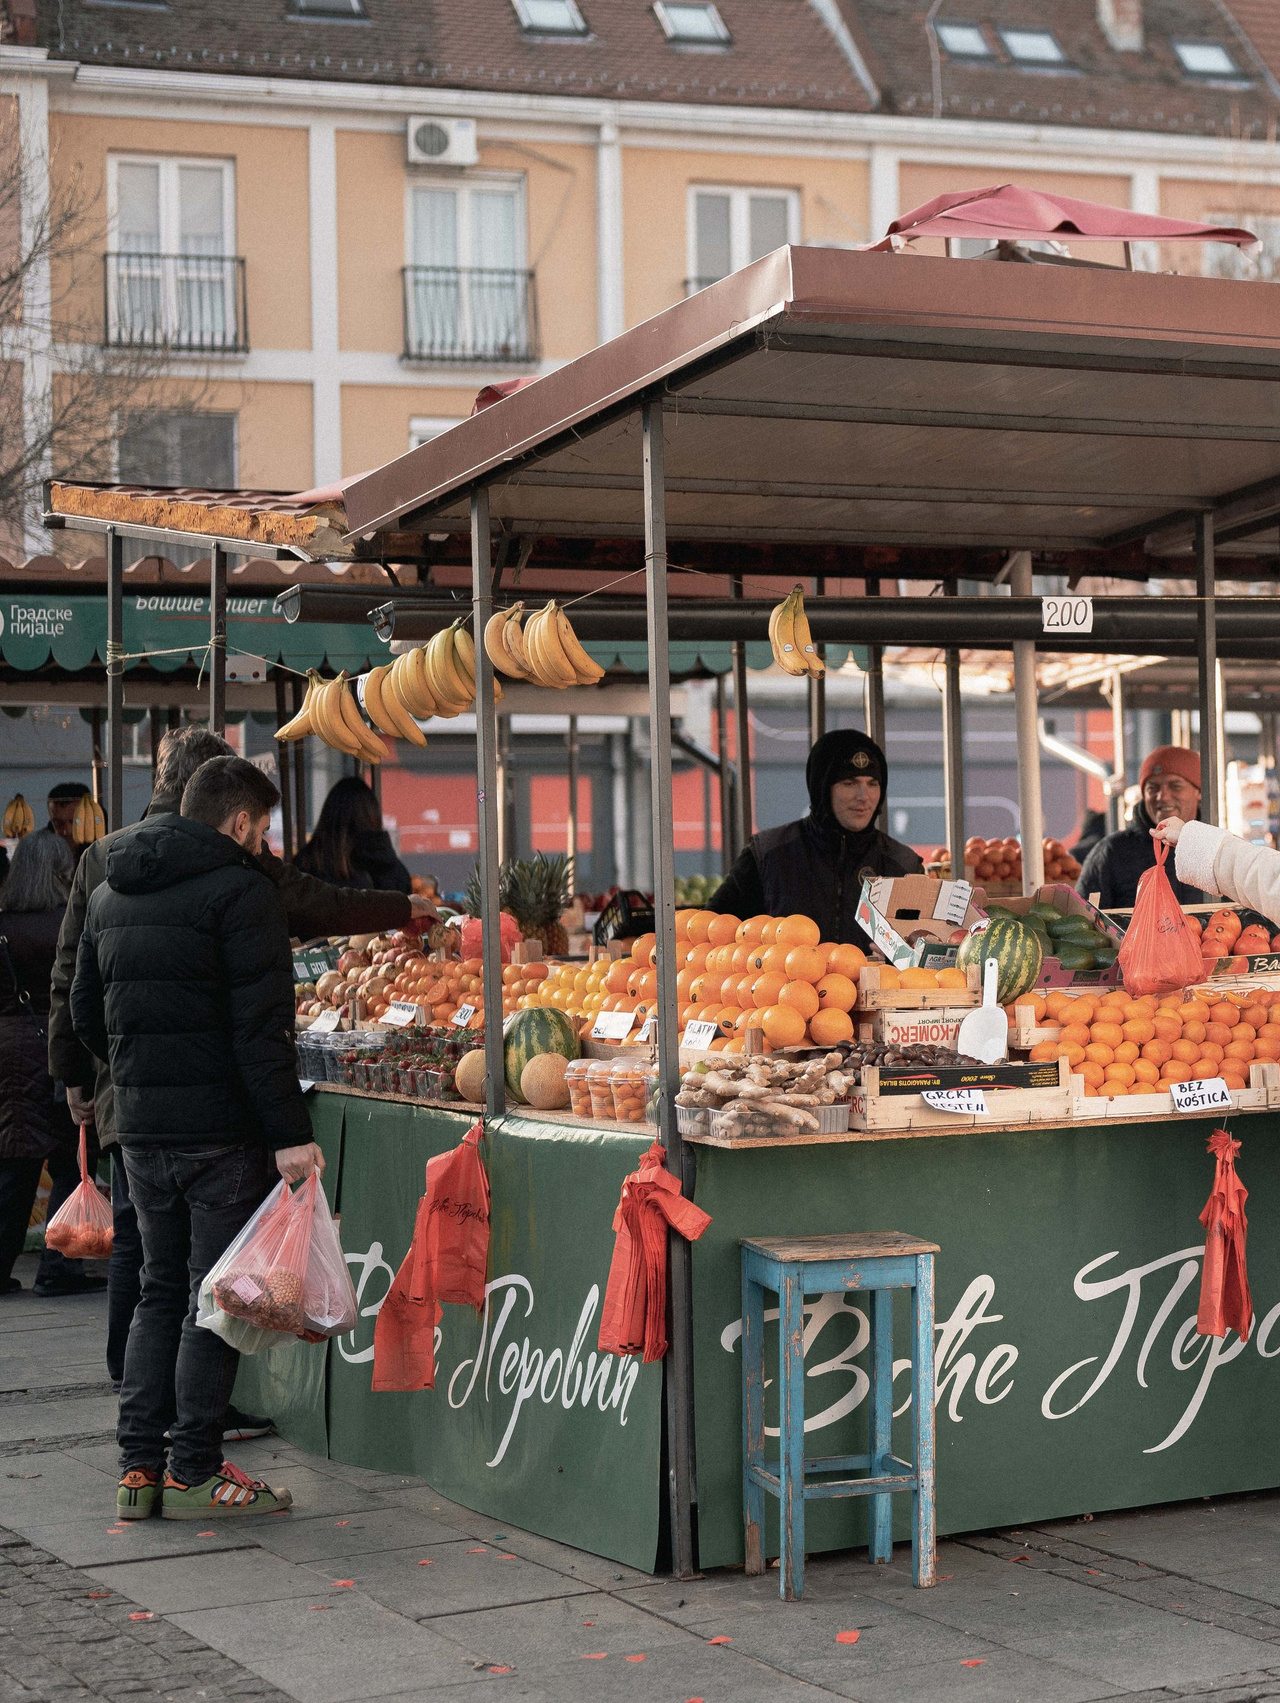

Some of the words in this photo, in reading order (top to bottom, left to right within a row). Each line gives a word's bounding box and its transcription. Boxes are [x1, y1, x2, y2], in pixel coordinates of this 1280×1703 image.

[10, 604, 73, 623] Градске
[1046, 599, 1088, 627] 200
[10, 622, 65, 638] пијаце
[455, 1007, 473, 1020] 300
[961, 1075, 978, 1083] 2000
[1178, 1081, 1205, 1093] BEZ
[1176, 1090, 1229, 1109] KOŠTICA
